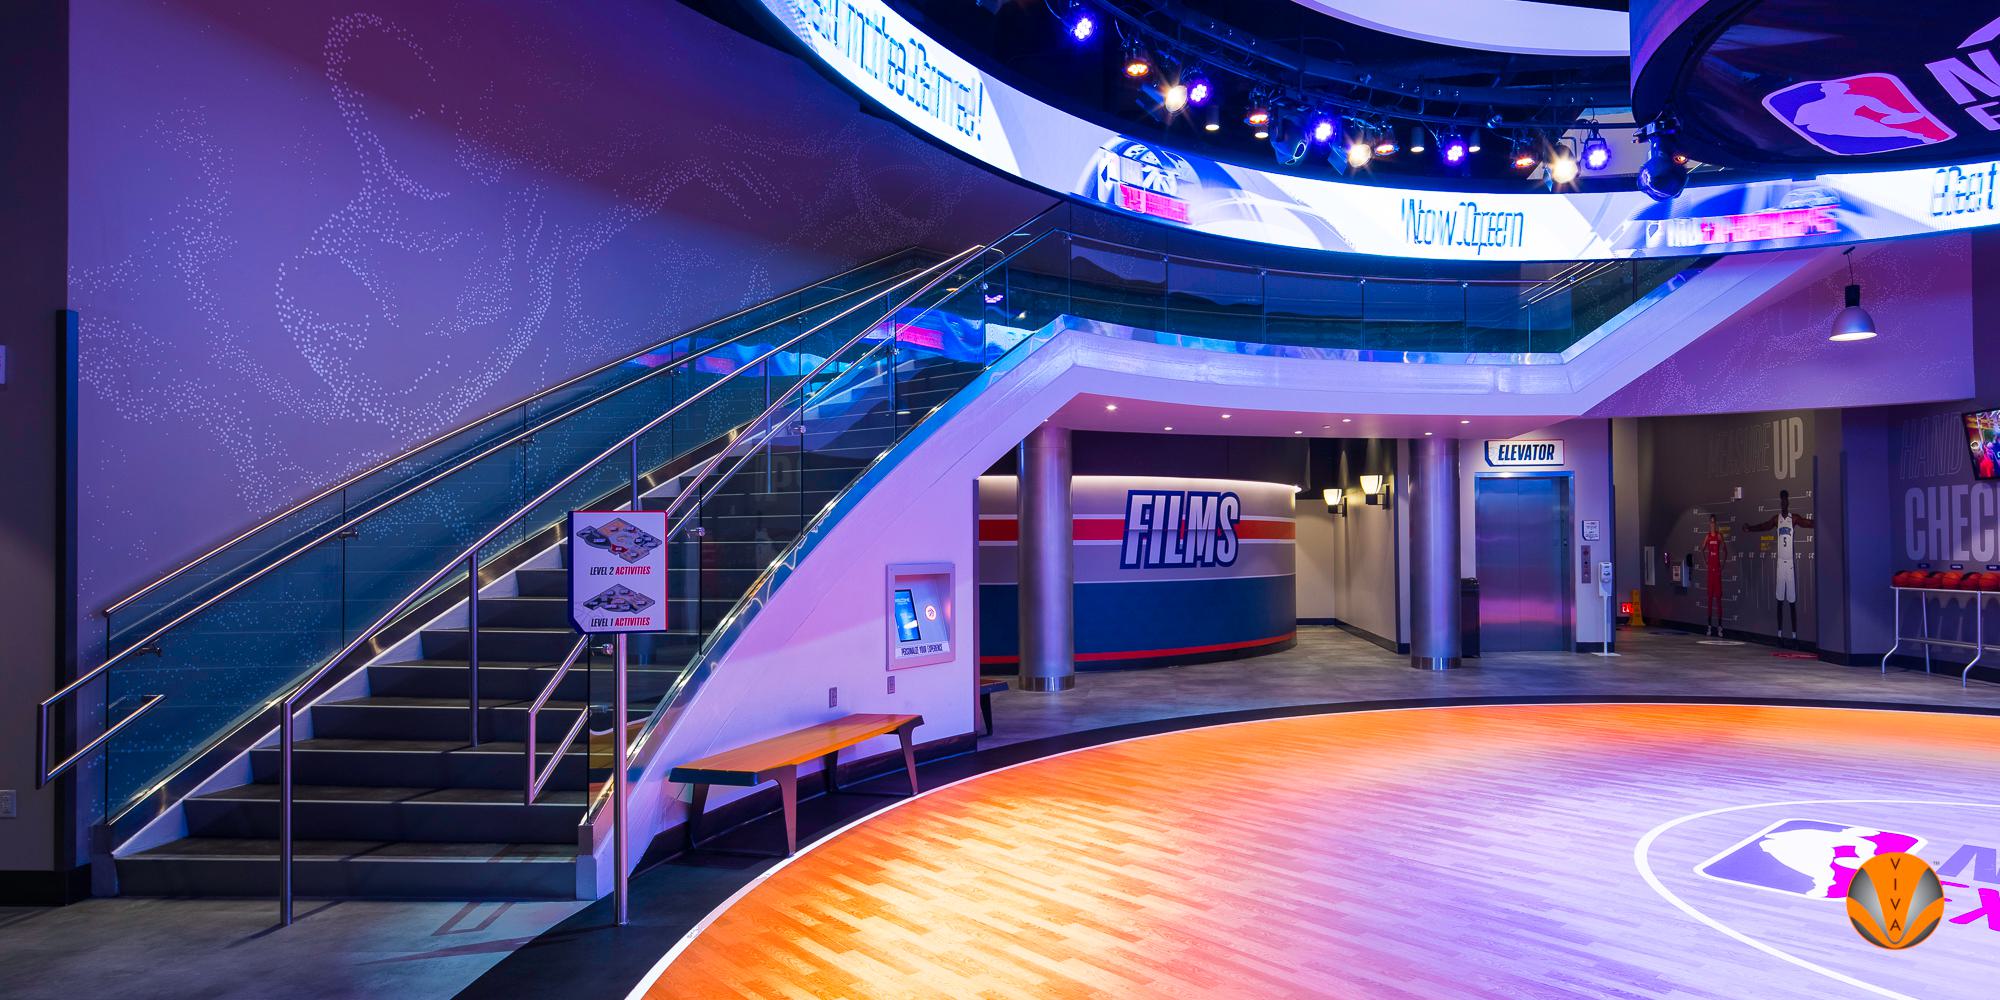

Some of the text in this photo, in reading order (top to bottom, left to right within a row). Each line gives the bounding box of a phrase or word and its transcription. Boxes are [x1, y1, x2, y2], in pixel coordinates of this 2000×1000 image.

[1401, 198, 1457, 246] Now
[1498, 443, 1555, 461] ELEVATOR
[1773, 416, 1804, 480] UP
[1900, 411, 1966, 480] HAND
[1120, 490, 1241, 569] FILMS
[1904, 482, 2000, 562] CHEC
[590, 566, 651, 576] LEVEL 2 ACTIVITIES
[591, 617, 651, 627] LEVEL 1 ACTIVITIES
